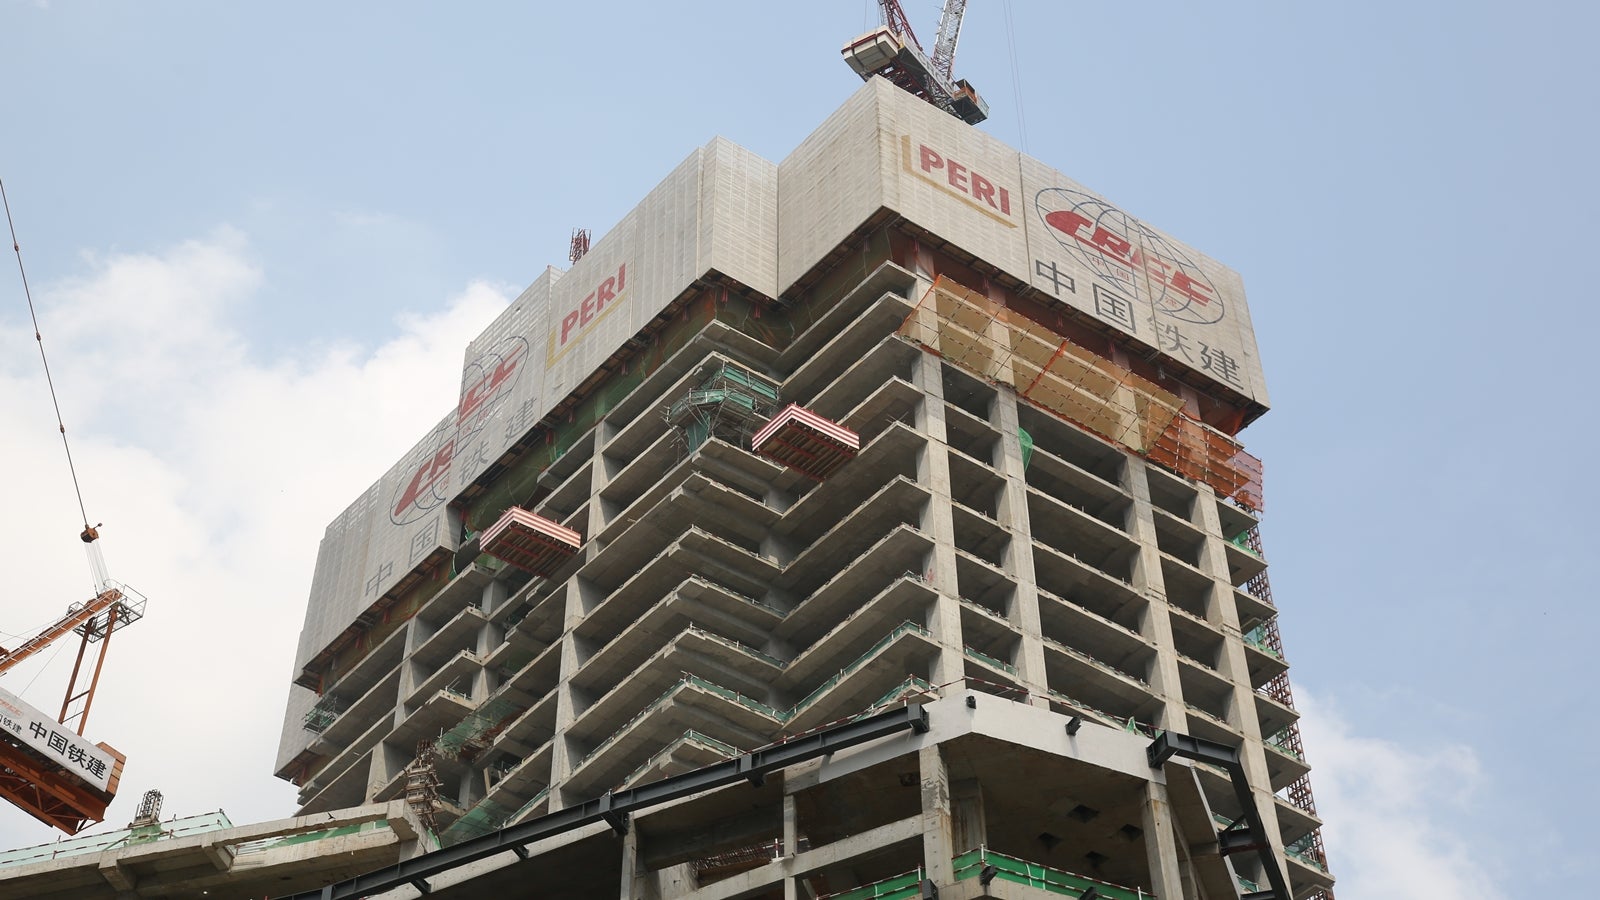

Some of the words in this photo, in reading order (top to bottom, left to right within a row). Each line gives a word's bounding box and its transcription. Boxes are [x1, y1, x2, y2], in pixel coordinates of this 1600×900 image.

[919, 144, 1012, 216] PERI
[560, 262, 627, 347] PERI
[1036, 259, 1245, 391] 中国铁建
[364, 396, 538, 597] 中国铁建
[28, 719, 108, 781] 中国铁建
